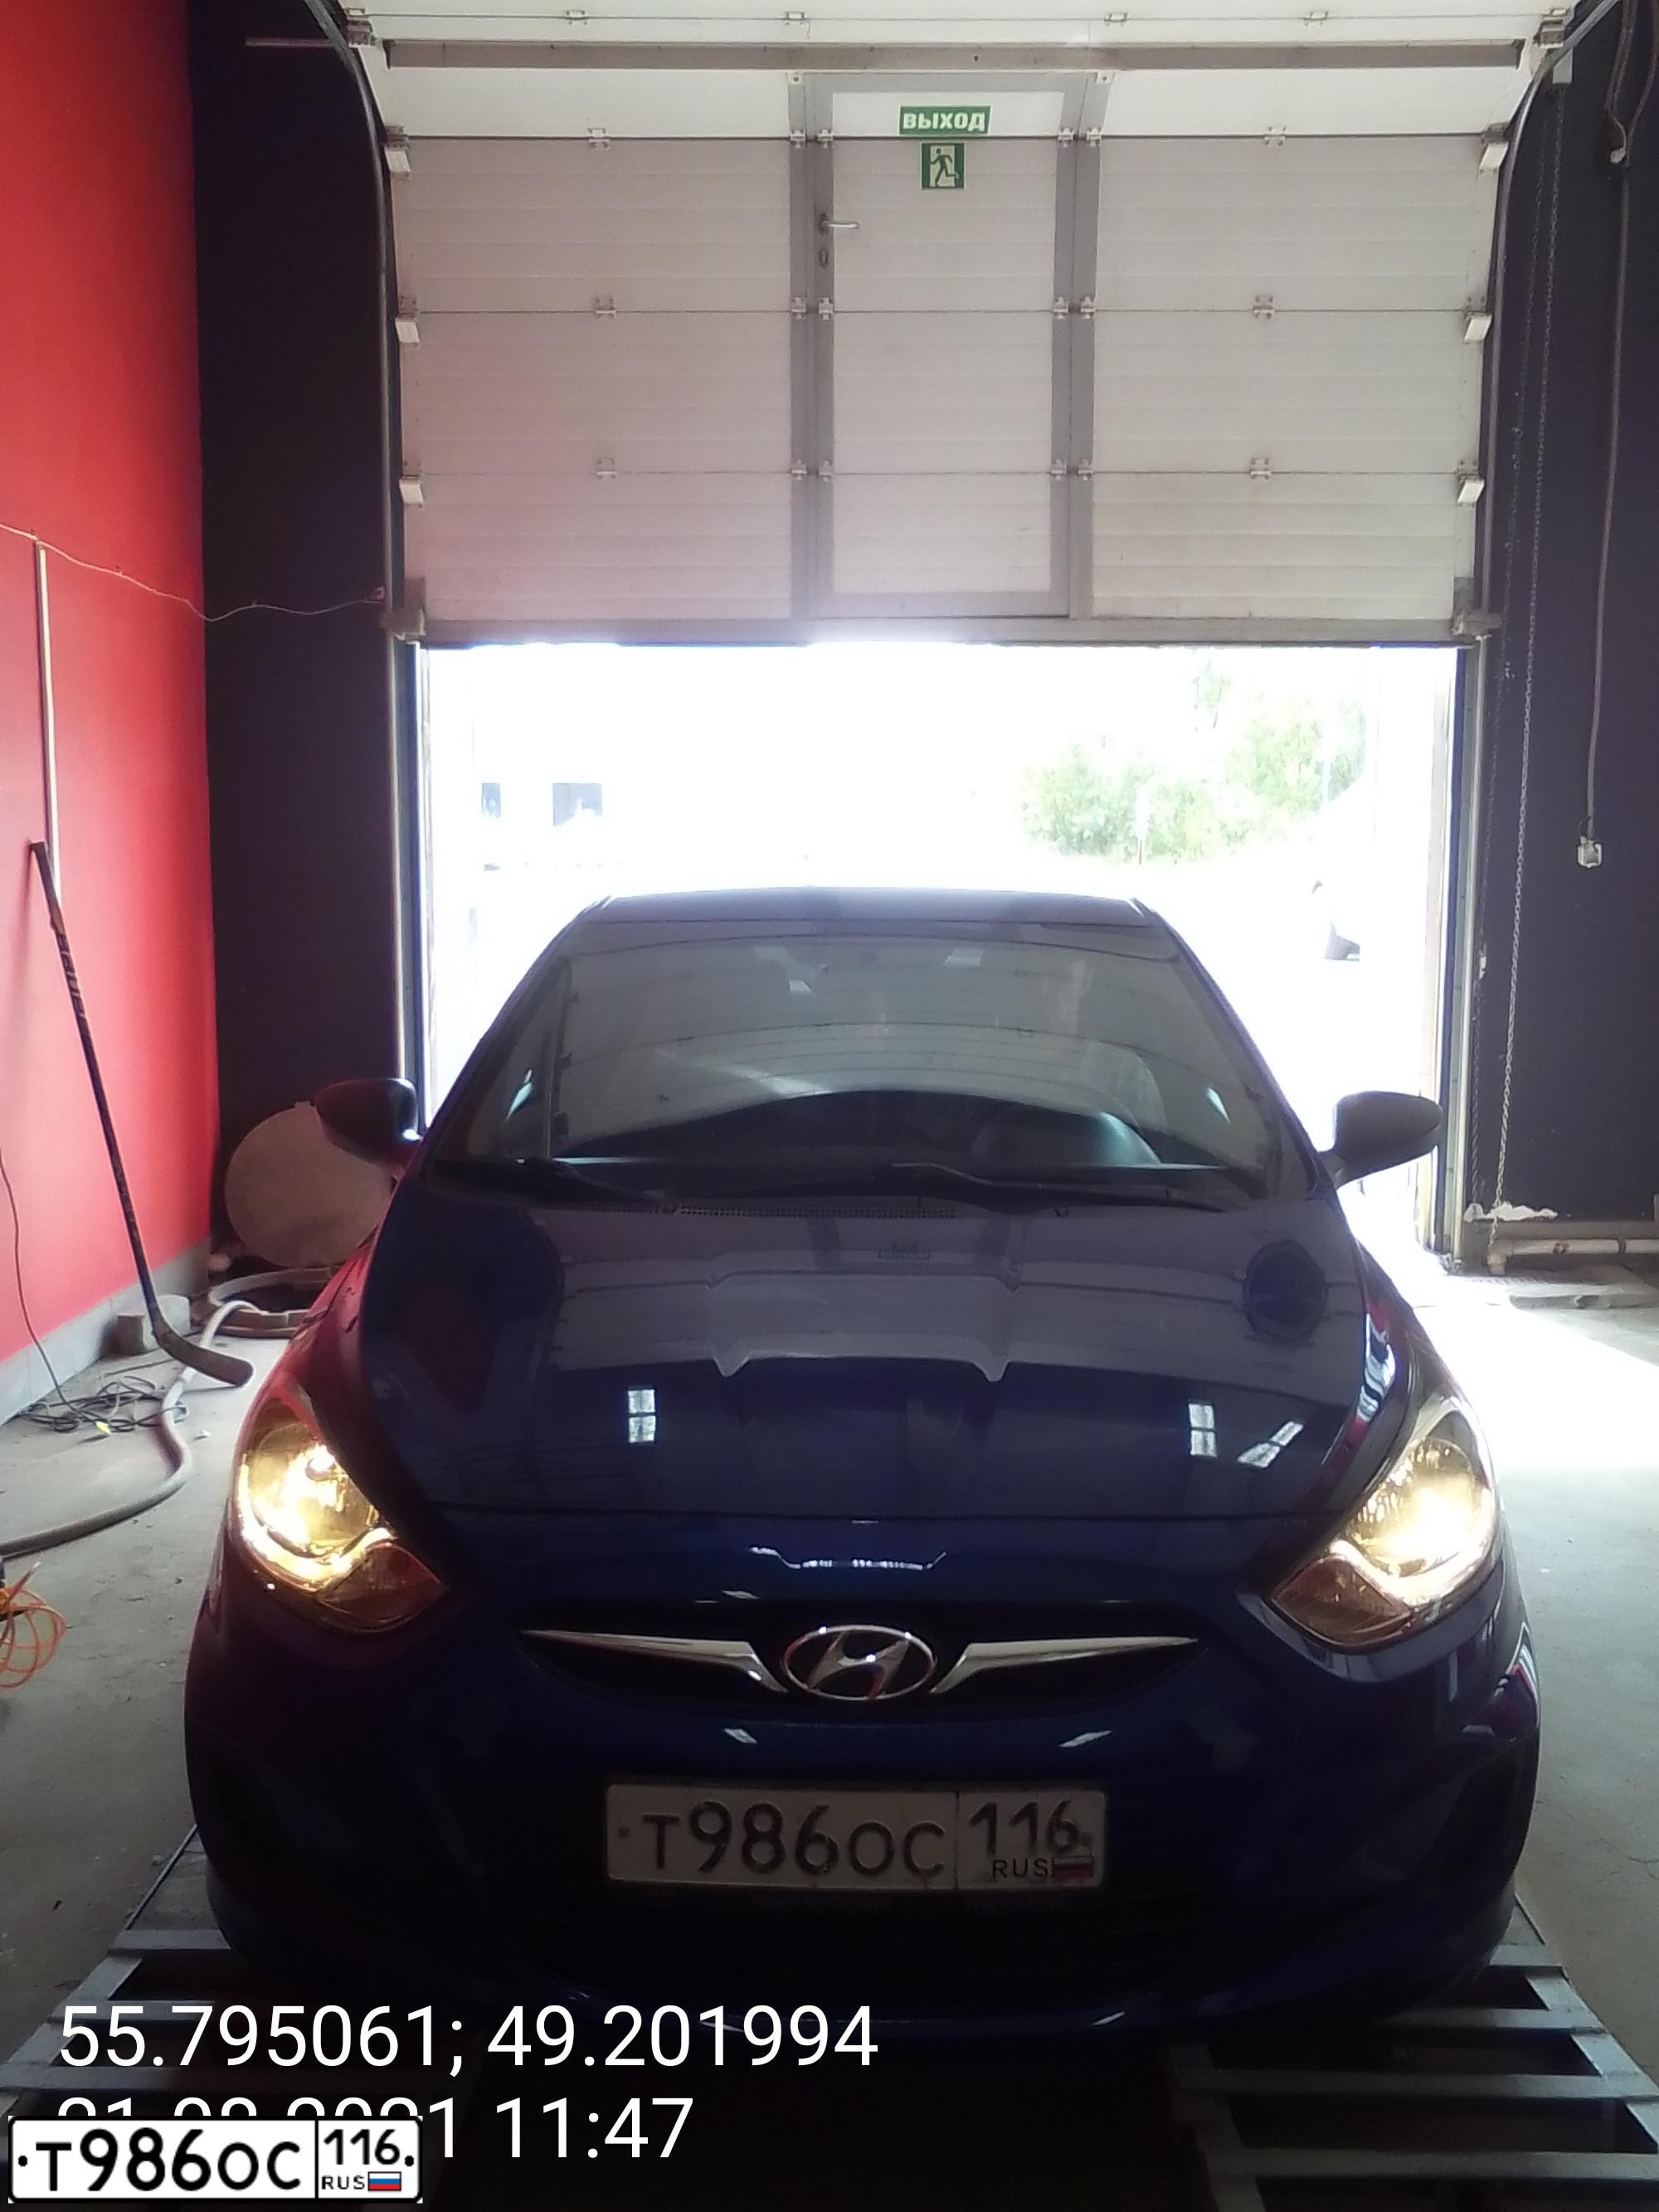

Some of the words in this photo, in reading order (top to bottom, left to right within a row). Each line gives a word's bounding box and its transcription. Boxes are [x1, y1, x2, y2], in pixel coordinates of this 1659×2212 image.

[902, 112, 985, 132] ВЫХОД
[969, 1799, 1082, 1854] 116
[991, 1858, 1048, 1879] RUS
